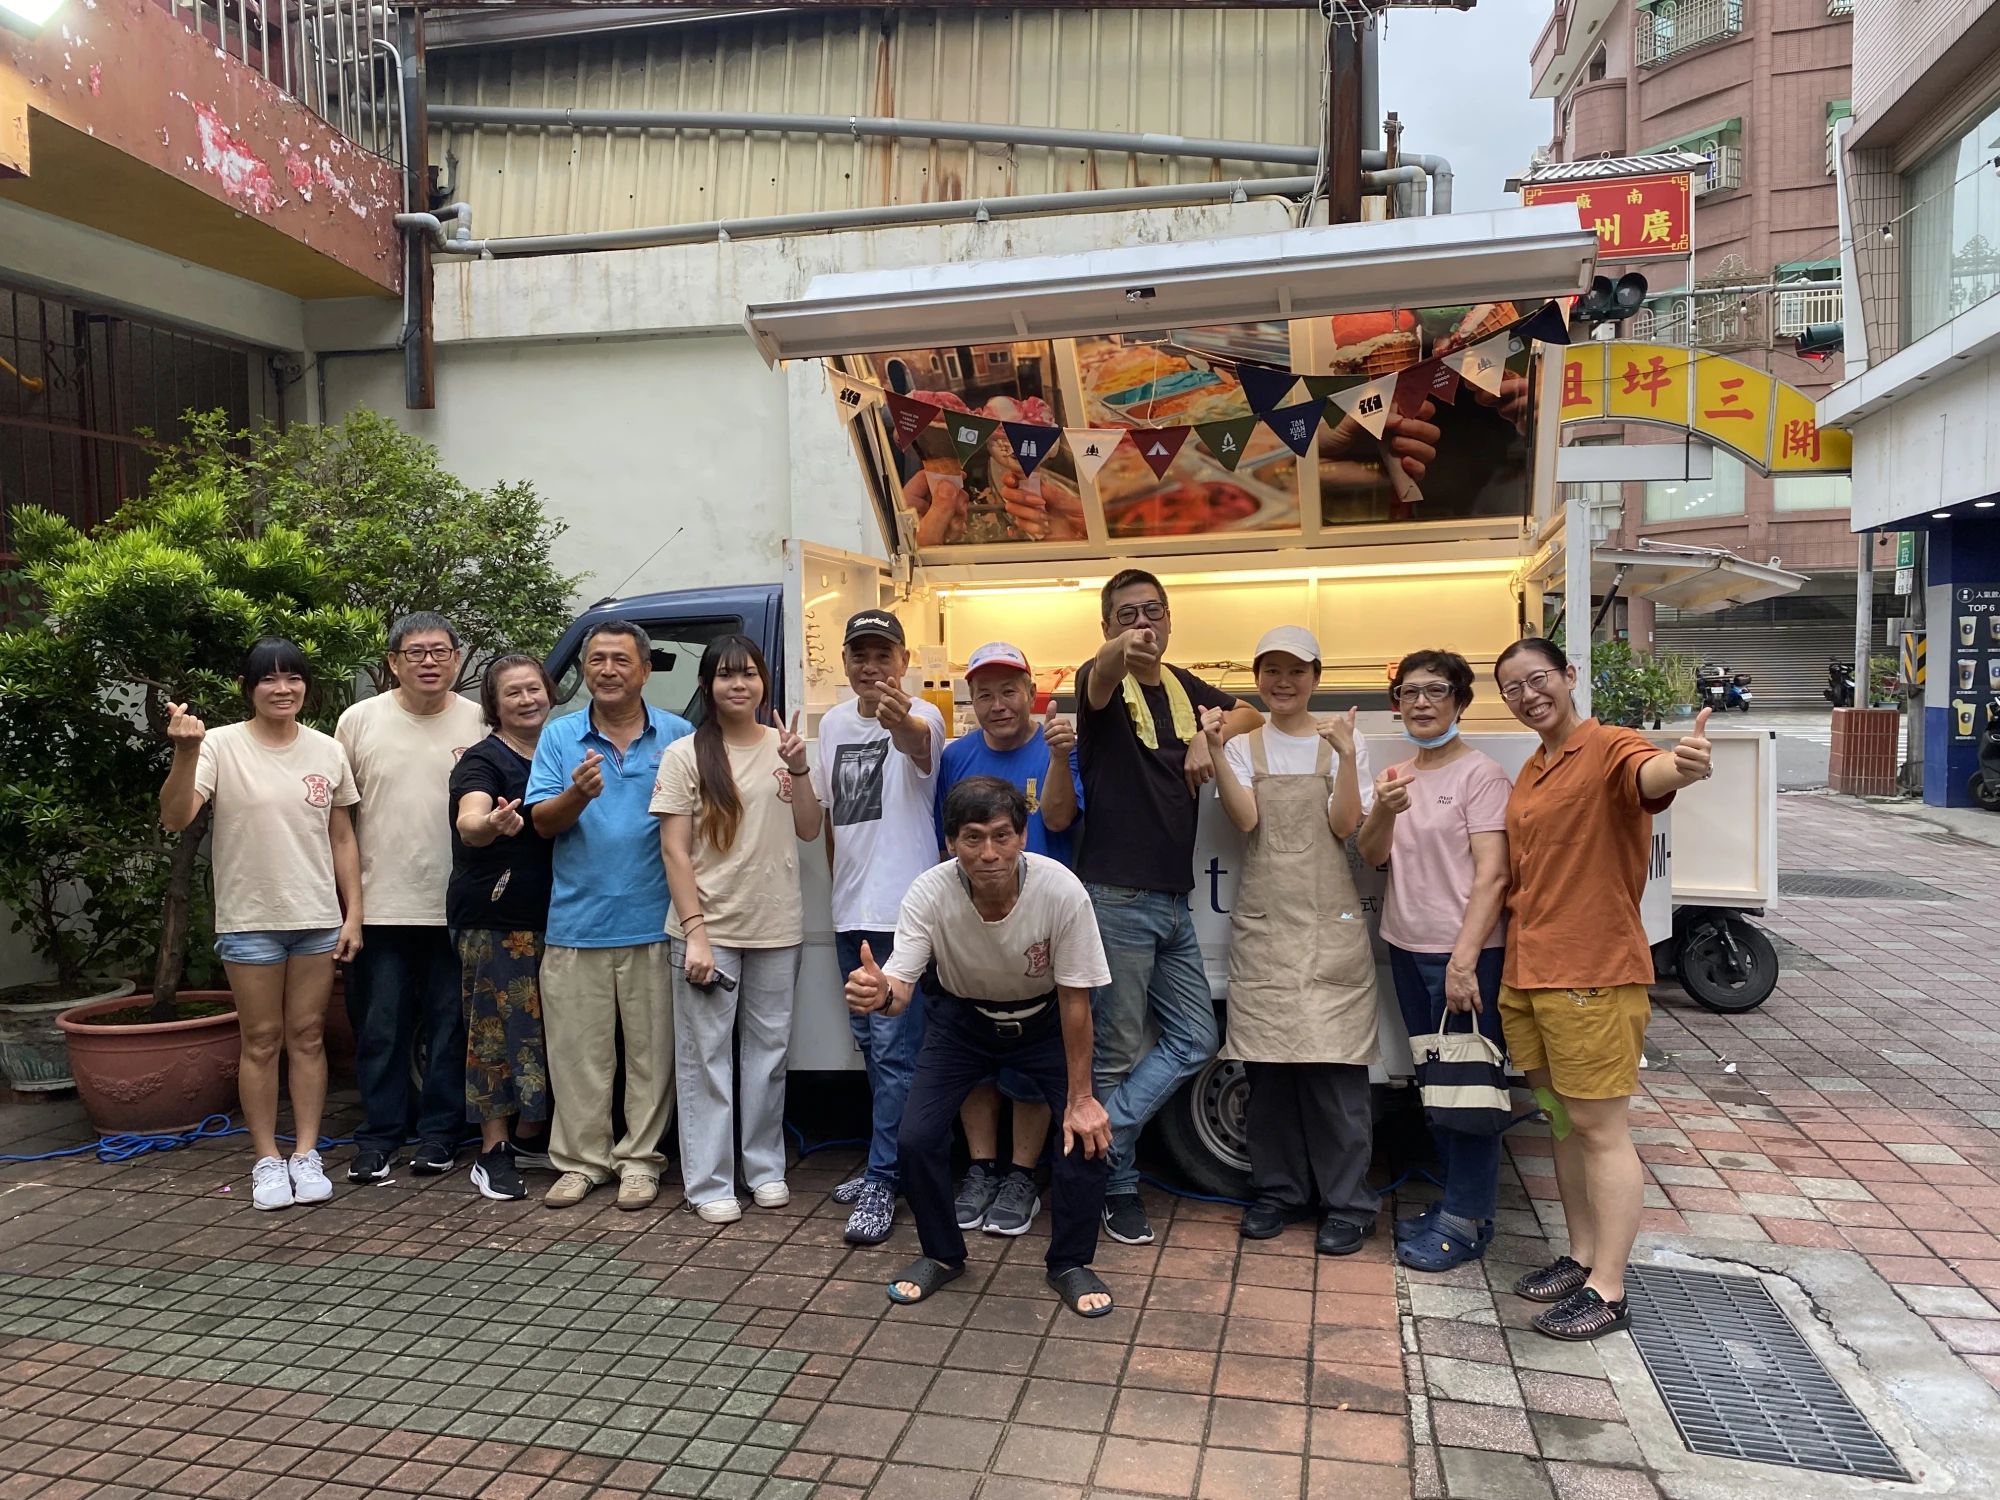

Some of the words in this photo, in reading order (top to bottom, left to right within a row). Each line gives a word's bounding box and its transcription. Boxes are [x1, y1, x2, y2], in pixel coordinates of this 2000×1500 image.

[1291, 418, 1304, 428] TAN
[1289, 426, 1306, 434] XIAN
[1293, 431, 1307, 441] ZHE
[1968, 604, 1988, 612] TOP
[1989, 604, 1995, 612] 6
